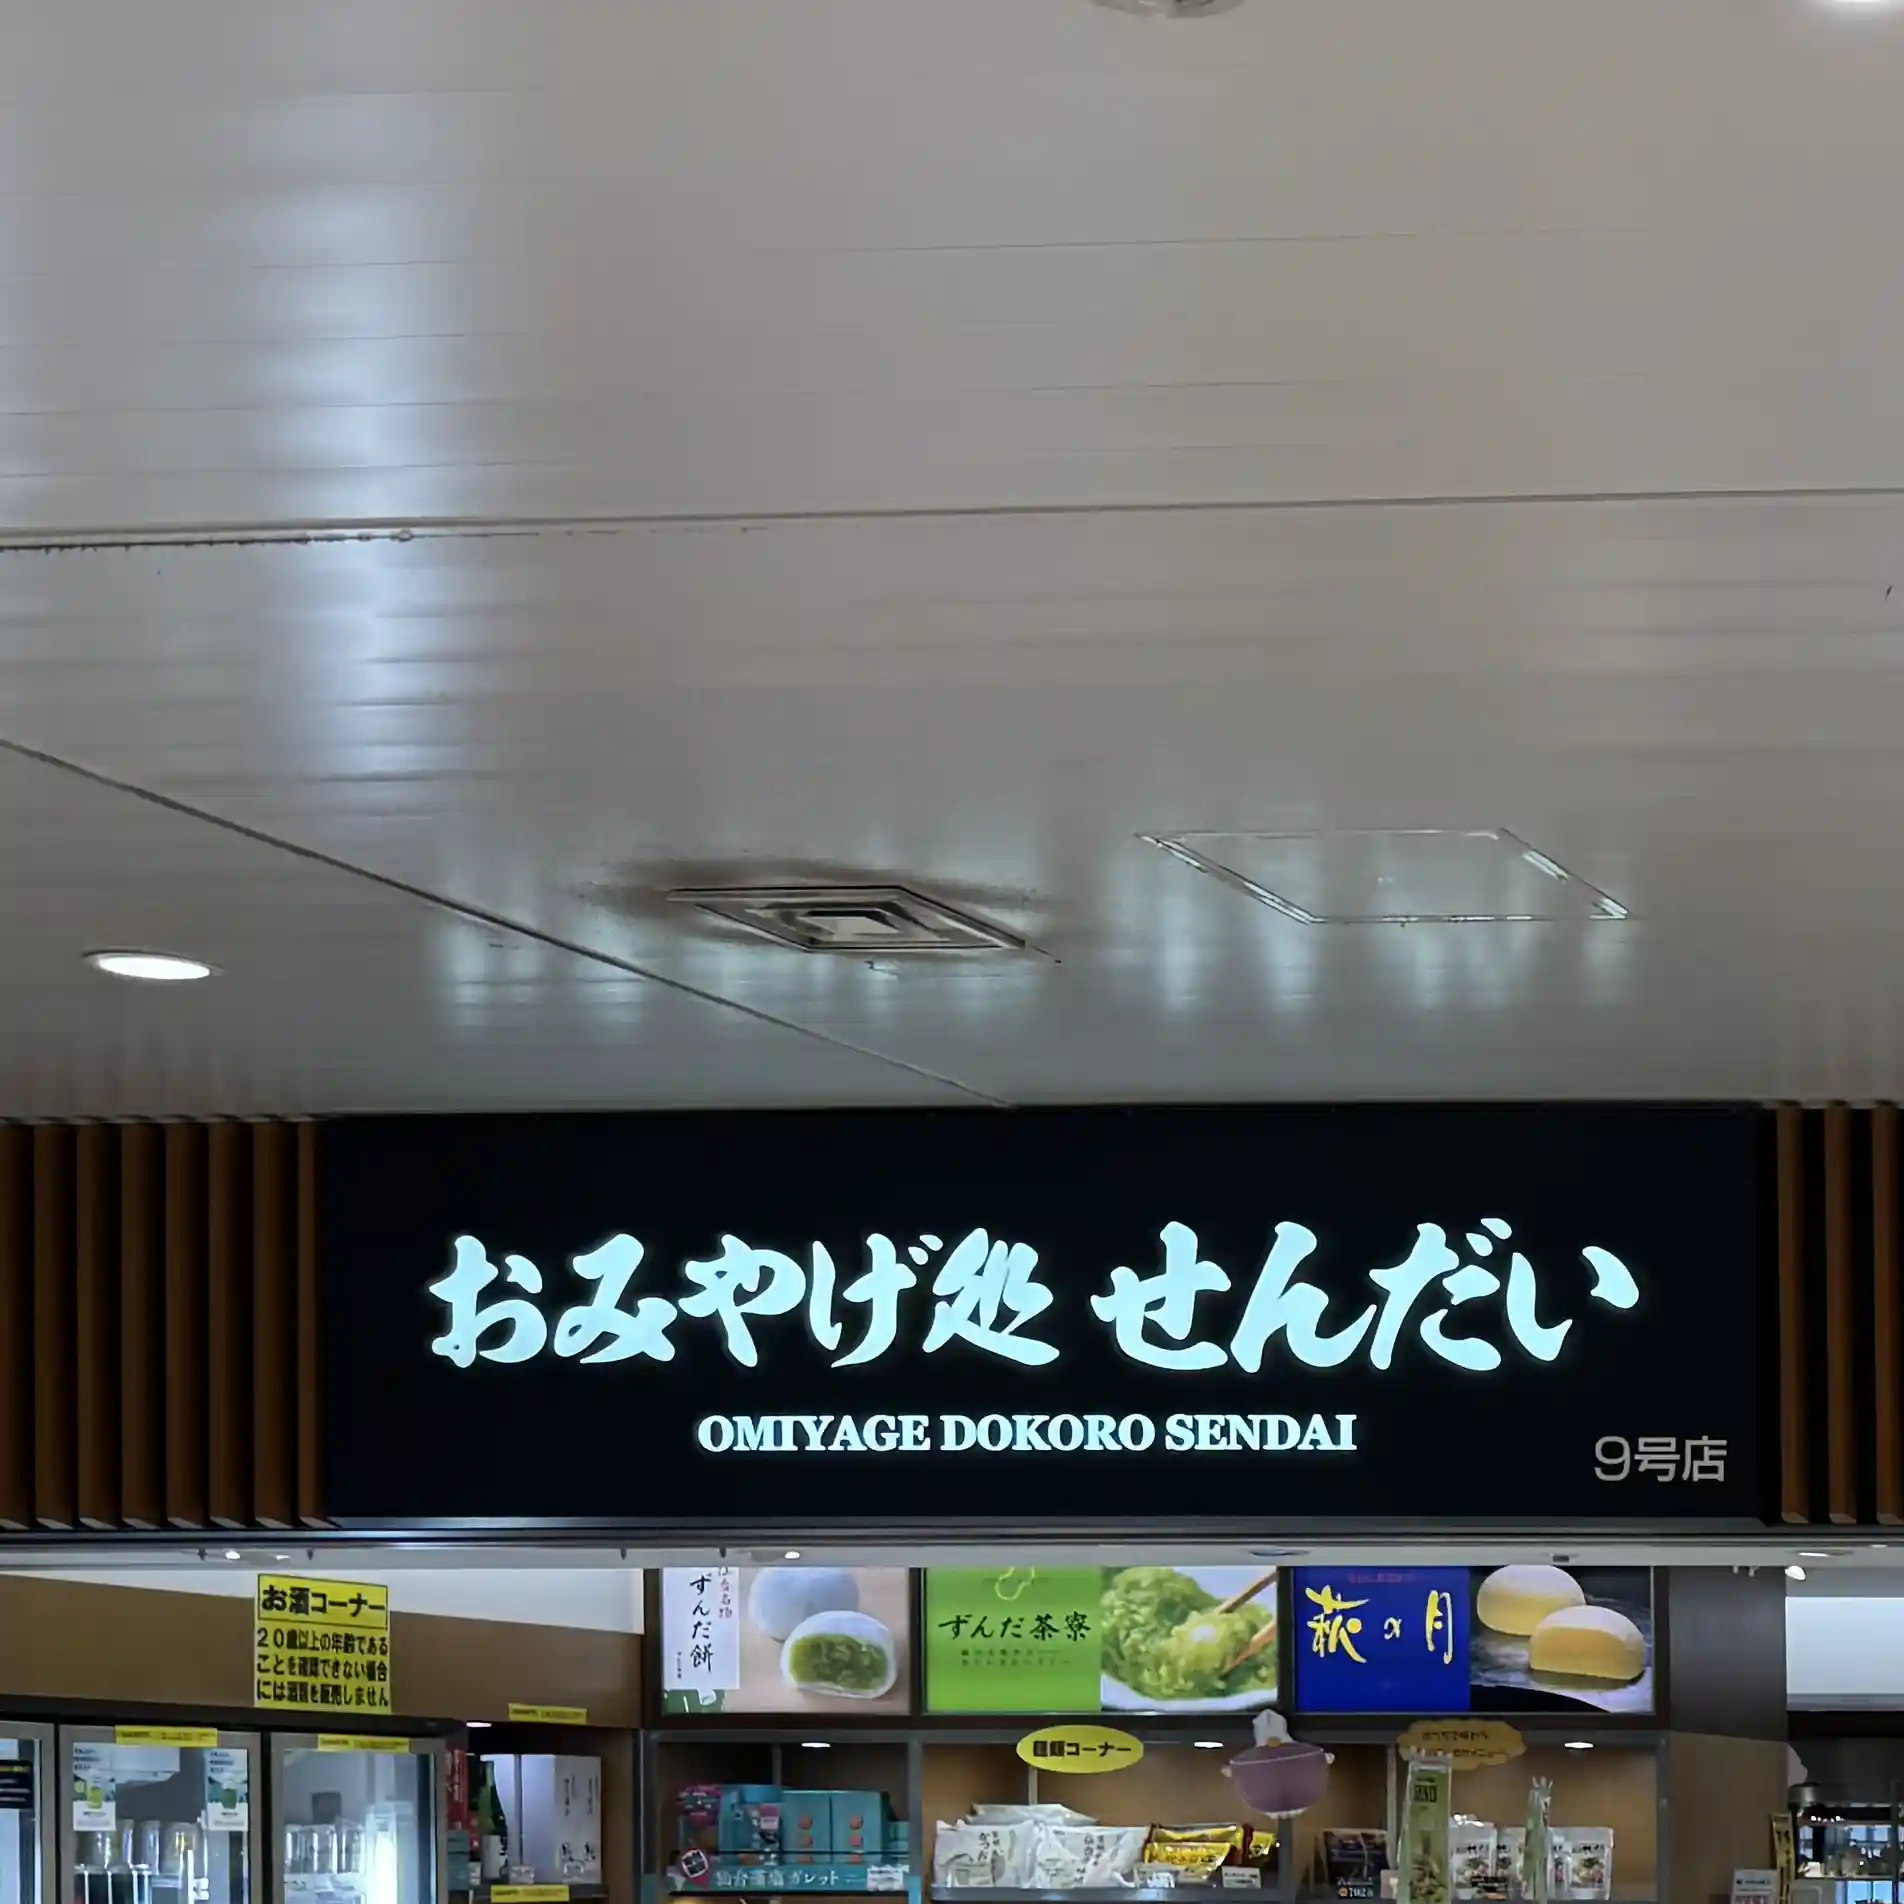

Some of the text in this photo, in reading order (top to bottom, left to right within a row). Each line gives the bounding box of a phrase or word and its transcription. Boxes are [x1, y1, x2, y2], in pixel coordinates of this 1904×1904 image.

[429, 1218, 1638, 1372] おみやげ処 せんだい
[698, 1414, 1356, 1452] OMIYAGE DOKORO SENDAI
[1593, 1434, 1727, 1482] 9号店
[261, 1584, 386, 1617] お酒コーナー
[689, 1573, 714, 1673] ずんだ餅
[937, 1611, 1092, 1642] ずんだ茶寮
